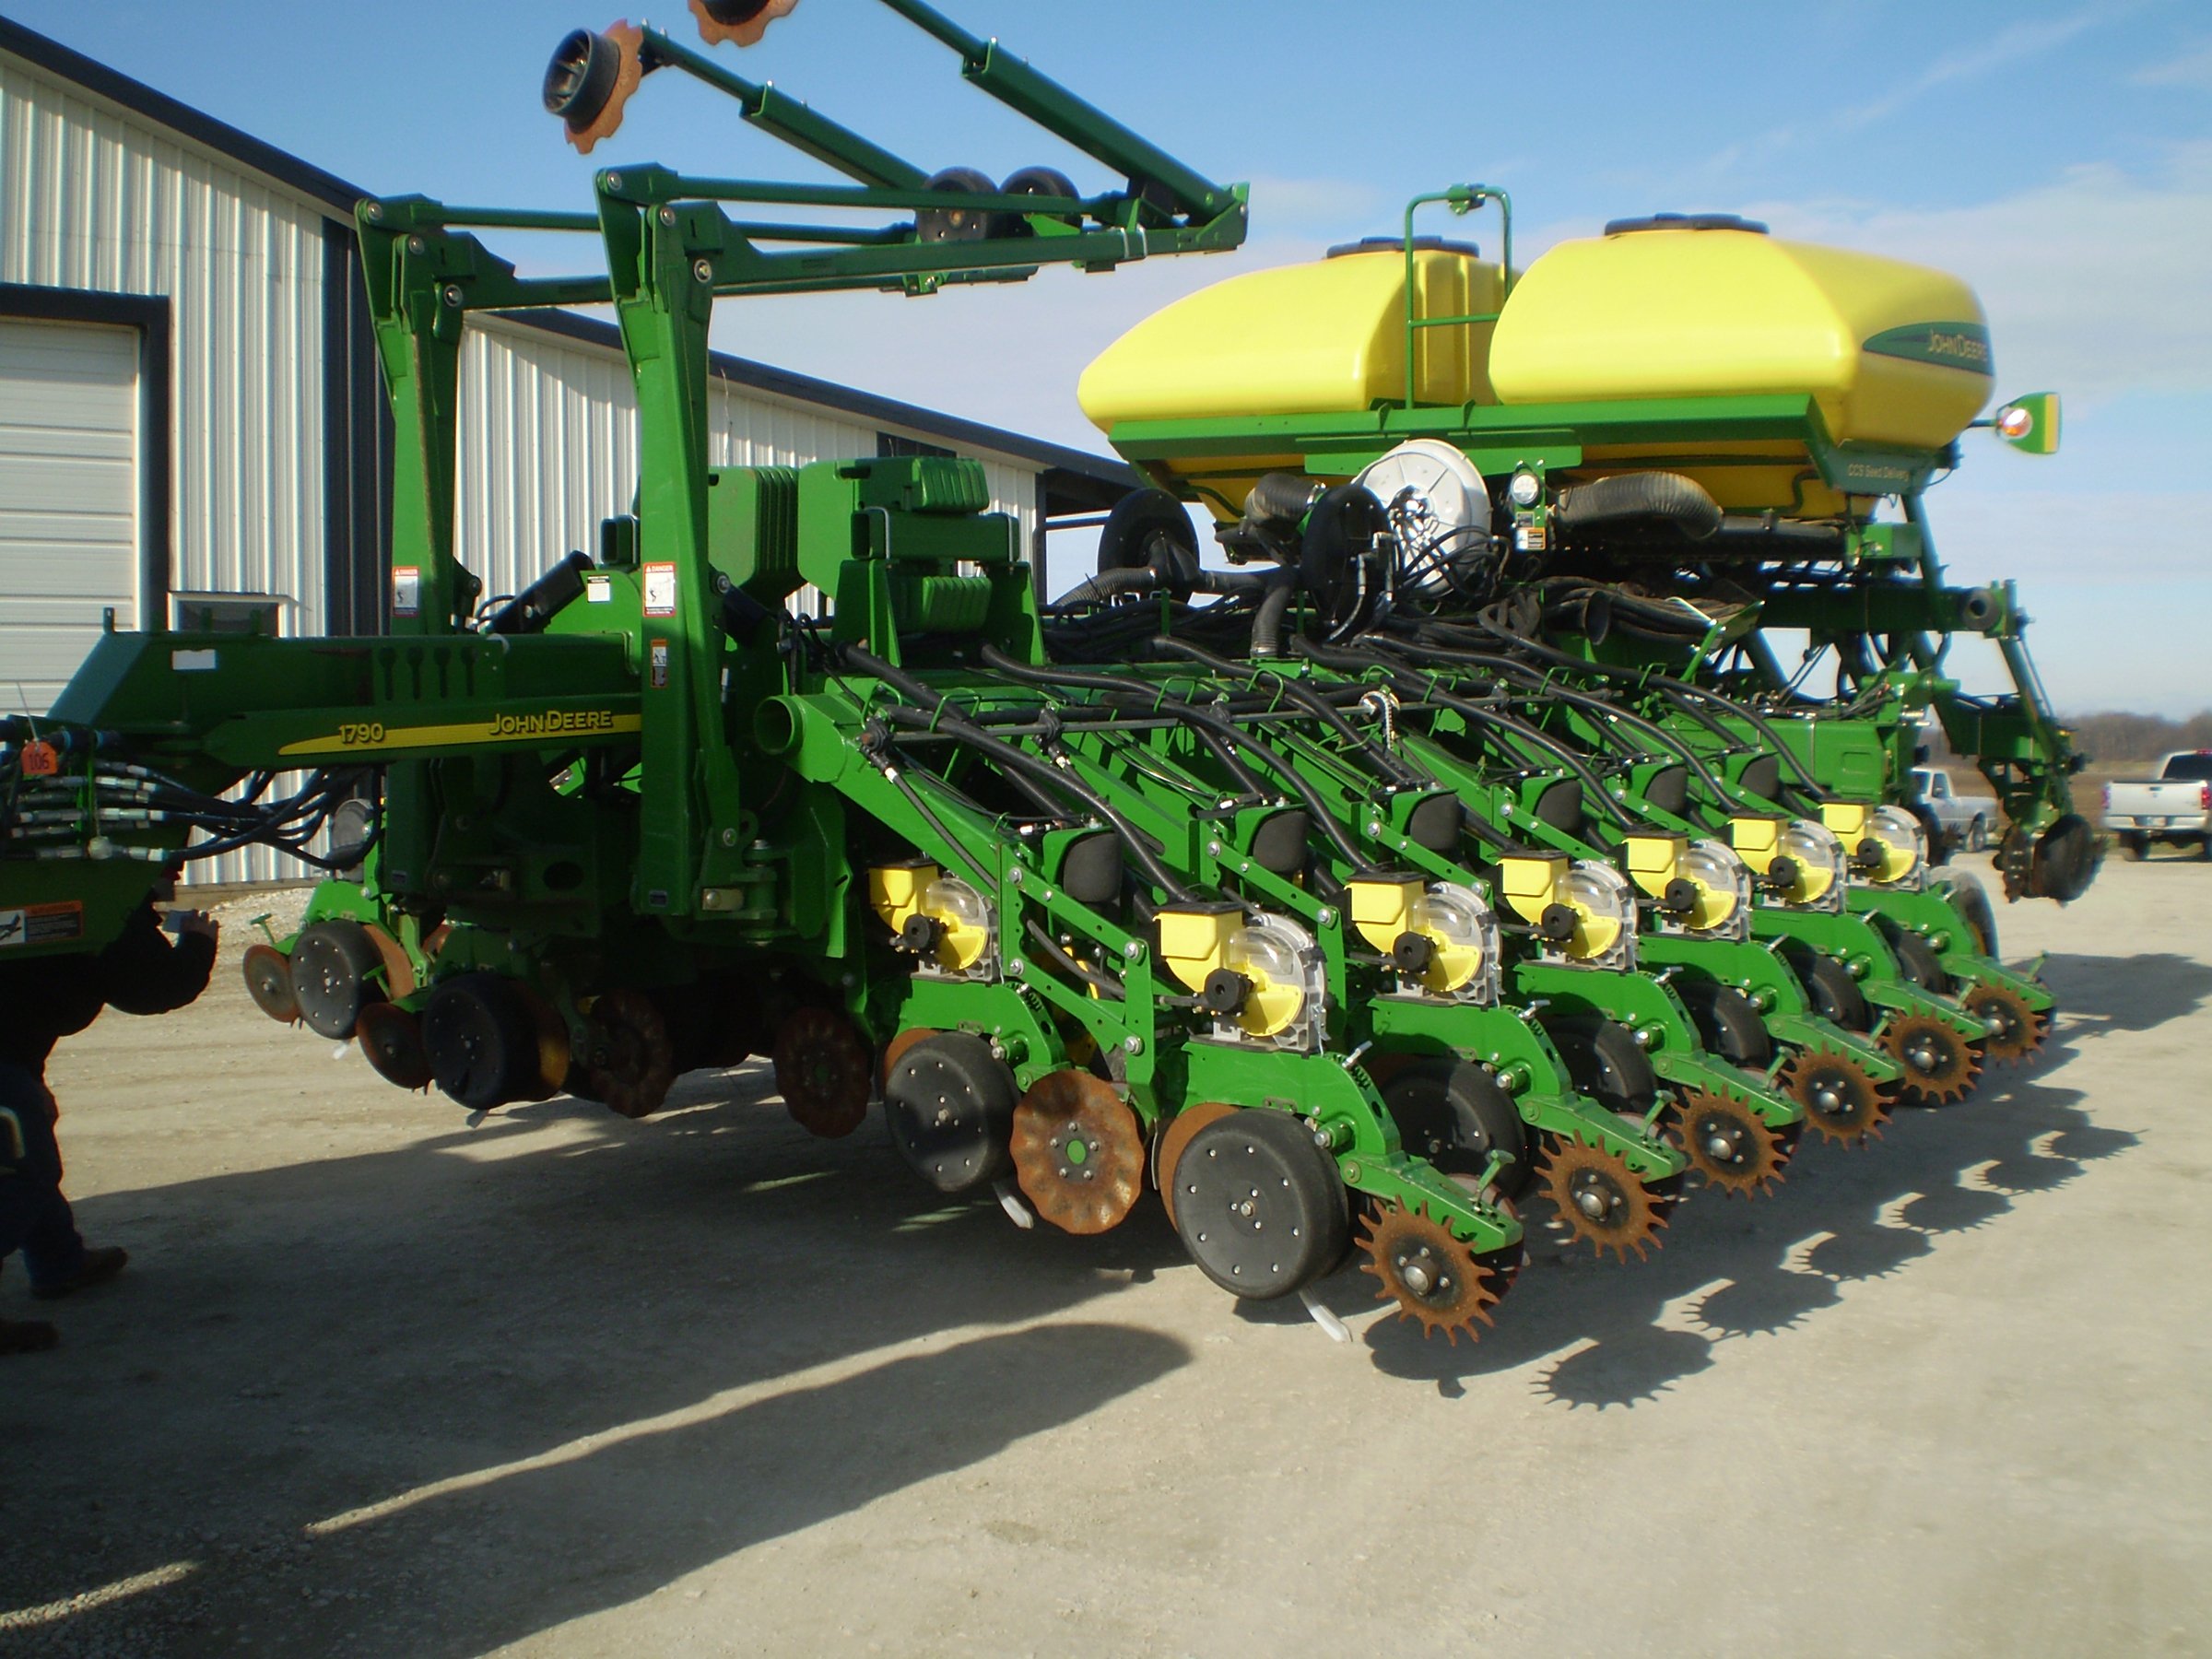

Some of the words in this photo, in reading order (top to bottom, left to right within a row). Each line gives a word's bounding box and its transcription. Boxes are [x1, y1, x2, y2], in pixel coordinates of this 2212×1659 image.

[339, 723, 384, 743] 1790
[489, 712, 545, 734] JOHN
[546, 710, 612, 730] DEERE
